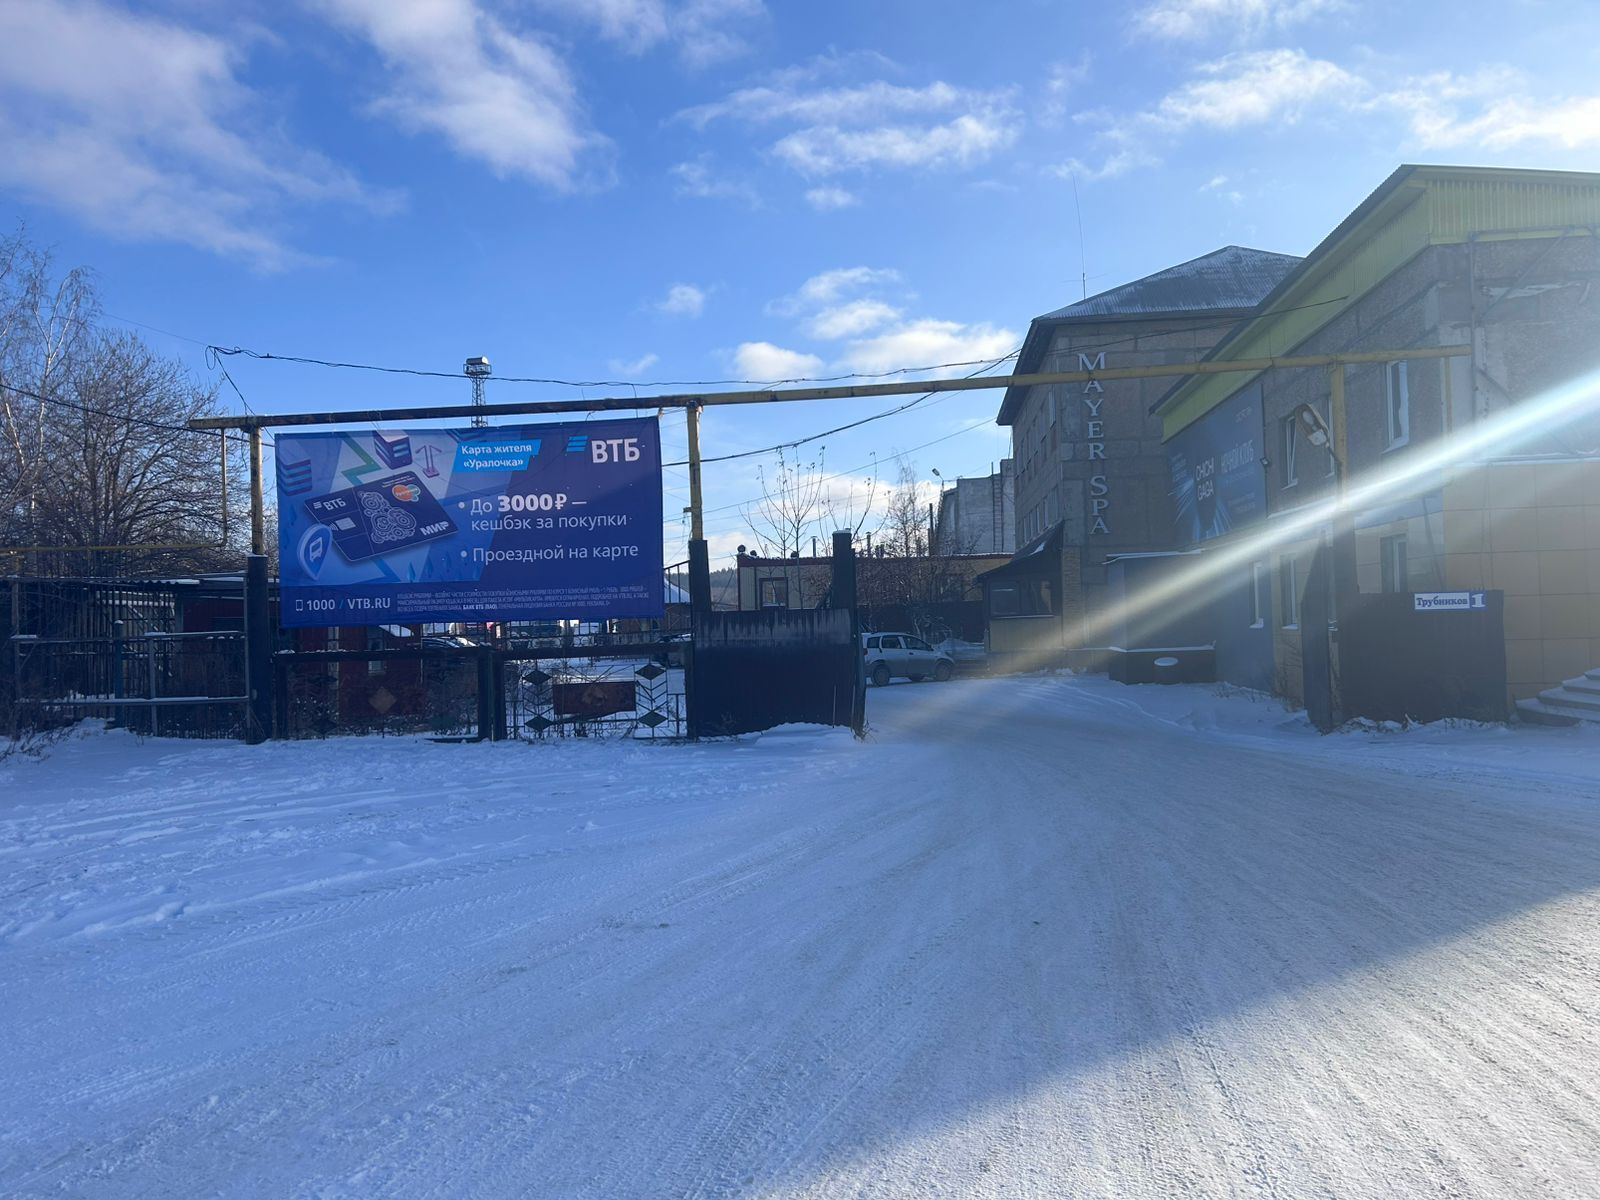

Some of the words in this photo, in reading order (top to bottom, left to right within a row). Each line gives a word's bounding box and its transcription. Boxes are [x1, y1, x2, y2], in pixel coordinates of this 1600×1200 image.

[1078, 351, 1107, 460] MAYER
[461, 444, 492, 456] Карта
[494, 442, 532, 454] жителя
[591, 438, 640, 464] ВТБ
[463, 458, 523, 470] «Уралочка»
[323, 497, 347, 511] ВТБ
[470, 498, 493, 516] До
[1089, 474, 1110, 535] SPA
[420, 521, 450, 537] МИР
[471, 514, 532, 531] кешбэк
[536, 518, 554, 529] за
[558, 514, 627, 531] покупки
[473, 545, 565, 565] Проездной
[569, 546, 588, 559] на
[592, 544, 639, 560] карте
[306, 599, 336, 611] 1000
[347, 597, 391, 610] VTB.RU
[1416, 596, 1468, 607] Трубников
[1471, 593, 1486, 608] 1
